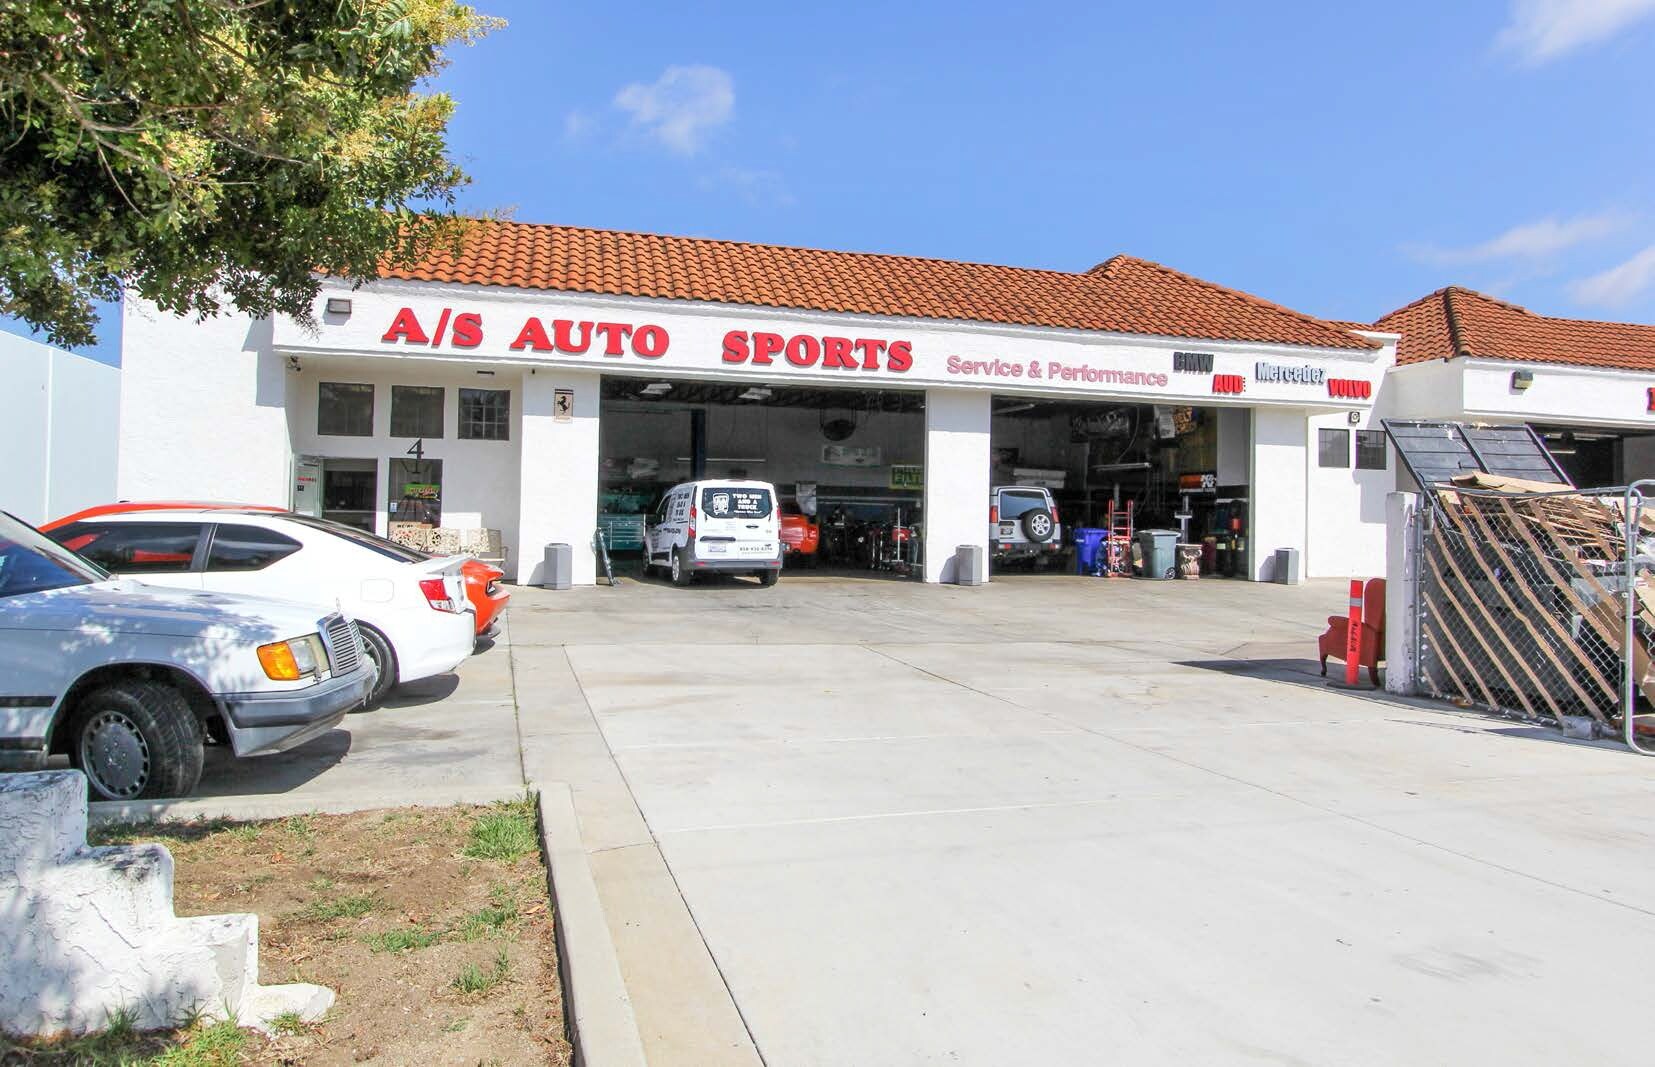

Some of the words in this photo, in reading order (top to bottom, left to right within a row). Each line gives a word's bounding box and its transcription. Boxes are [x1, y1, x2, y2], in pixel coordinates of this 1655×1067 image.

[381, 307, 484, 348] A/S
[509, 317, 670, 358] AUTO
[722, 330, 914, 372] SPORTS
[946, 355, 1023, 377] Service
[1027, 360, 1042, 379] &
[1048, 361, 1168, 387] Performance
[1173, 352, 1214, 373] BMW
[1327, 378, 1371, 398] VOLVO
